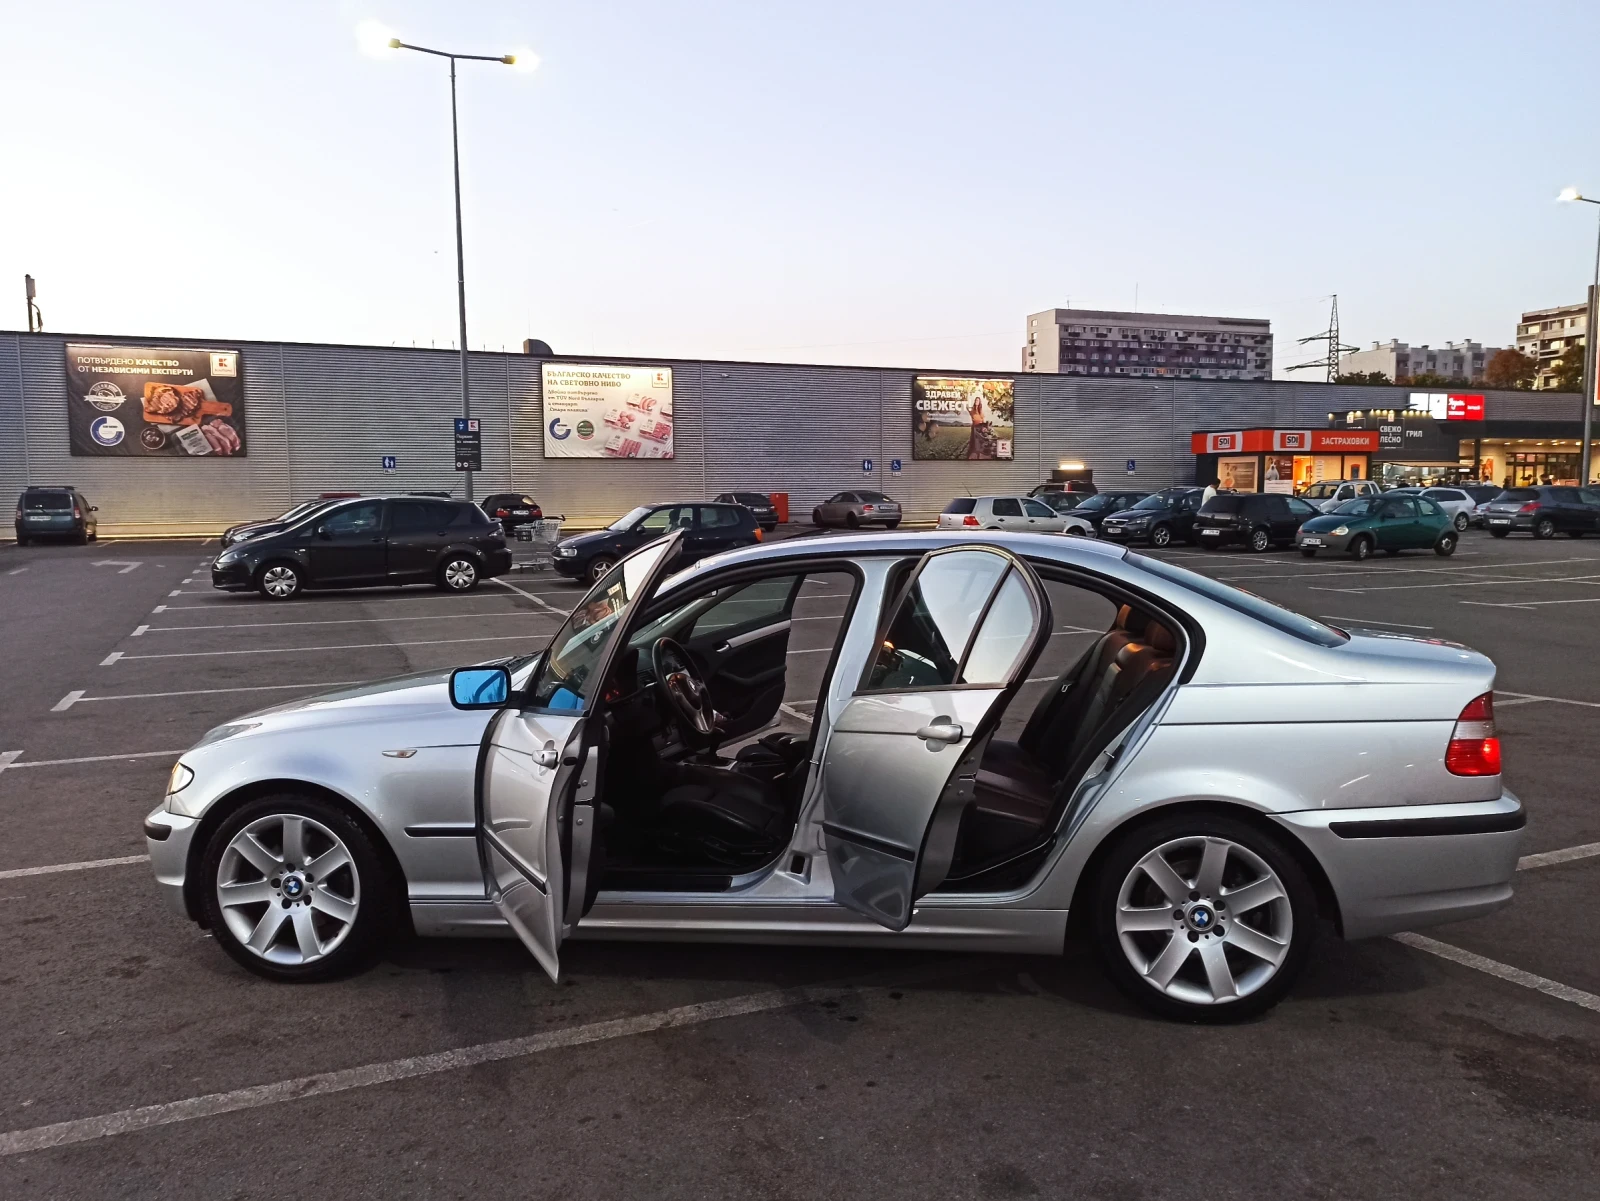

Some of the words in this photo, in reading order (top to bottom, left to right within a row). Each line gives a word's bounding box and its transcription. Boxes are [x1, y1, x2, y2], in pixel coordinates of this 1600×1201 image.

[77, 356, 134, 365] ПОТВЪРДЕНО
[135, 358, 179, 366] КАЧЕСТВО
[92, 366, 150, 375] НЕЗАВИСИМИ
[151, 367, 194, 376] ЕКСПЕРТИ
[916, 399, 972, 411] СВЕЖЕСТ!
[1379, 425, 1402, 433] СВЕЖО
[1405, 430, 1423, 438] ГРИЛ
[1218, 437, 1230, 446] SDI
[1286, 435, 1299, 444] SDI
[1321, 437, 1370, 445] ЗАСТРАХОВКИ
